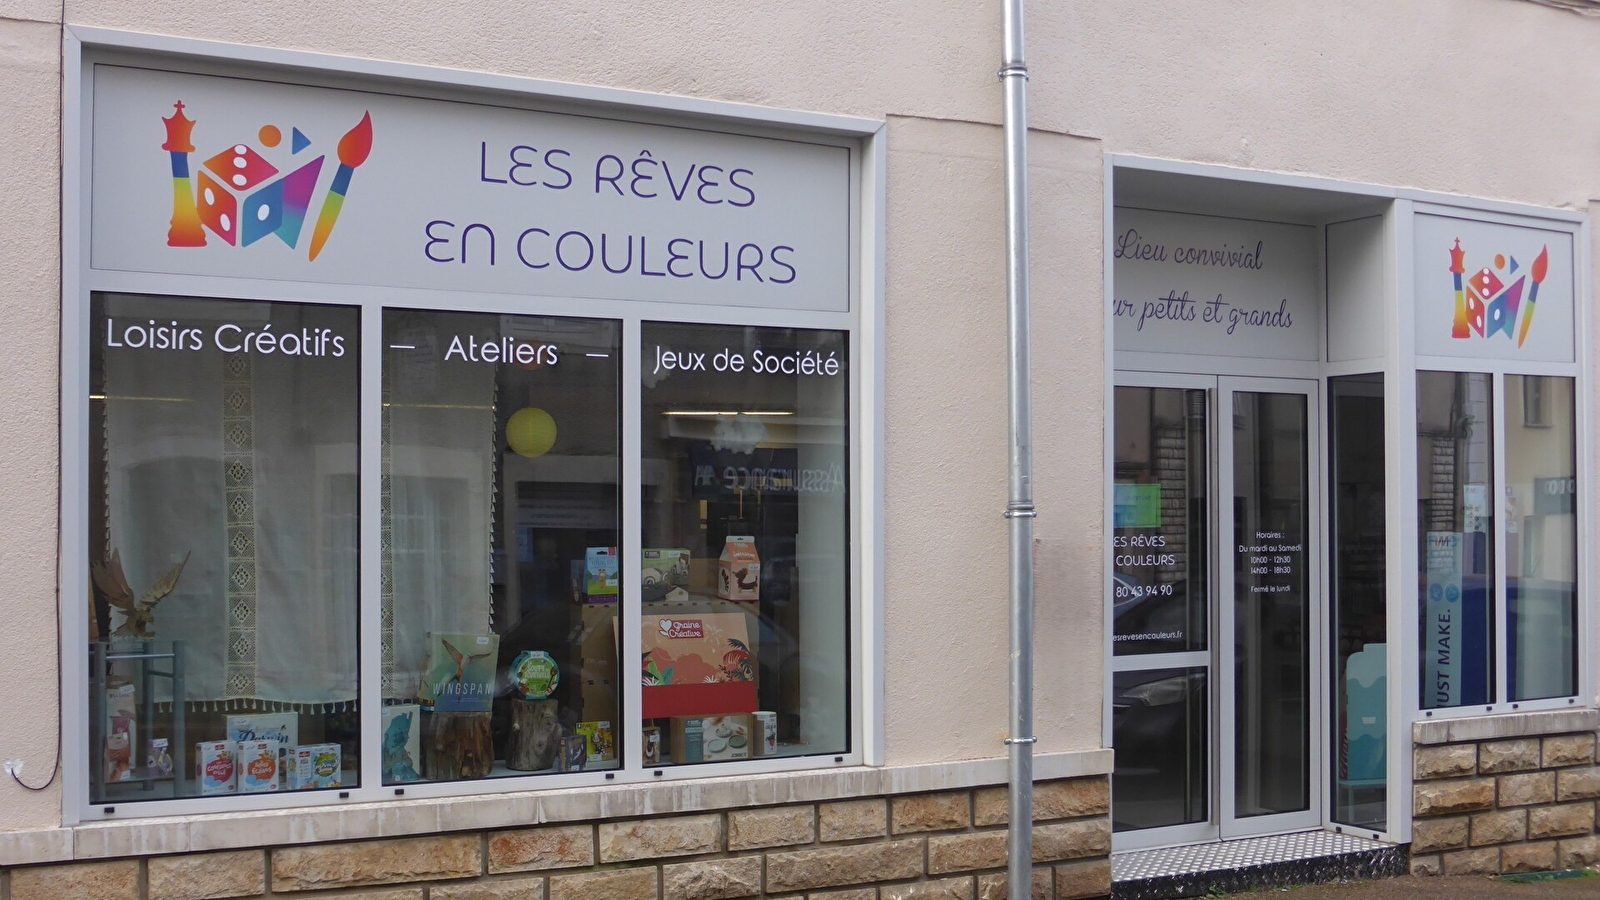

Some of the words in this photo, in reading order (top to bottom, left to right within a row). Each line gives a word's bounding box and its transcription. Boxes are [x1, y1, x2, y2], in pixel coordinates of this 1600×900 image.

[481, 141, 573, 190] LES
[594, 149, 756, 208] RÊVES
[516, 227, 797, 285] COULEURS
[1114, 228, 1168, 260] Lieu
[1174, 240, 1264, 271] convivial
[1113, 298, 1137, 318] ur
[1137, 289, 1197, 332] petits
[1203, 293, 1230, 324] et
[1226, 298, 1294, 335] grands
[107, 318, 203, 351] Loisirs
[214, 323, 346, 358] Créatifs
[444, 334, 559, 367] Ateliers
[652, 345, 707, 376] Jeux
[713, 347, 745, 373] de
[751, 349, 840, 377] Société
[1113, 536, 1128, 548] ES
[1130, 533, 1166, 547] RÊVES
[1256, 530, 1282, 539] Horaires
[1238, 544, 1249, 553] Du
[1249, 544, 1268, 552] mardi
[1278, 543, 1302, 552] Samedi
[1115, 554, 1176, 567] COULEURS
[1250, 556, 1268, 564] 10h00
[1273, 555, 1291, 564] 12h30
[1250, 566, 1268, 575] 14h00
[1273, 566, 1291, 574] 18h30
[1115, 586, 1129, 598] 80
[1130, 585, 1143, 597] 43
[1145, 585, 1158, 597] 94
[1160, 584, 1173, 596] 90
[1250, 585, 1269, 593] Fermé
[1269, 585, 1276, 593] le
[1276, 584, 1291, 592] lundi
[1113, 630, 1183, 642] esrevesencouleurs.fr
[1437, 609, 1451, 666] MAKE.
[432, 682, 492, 696] WINGSPAN
